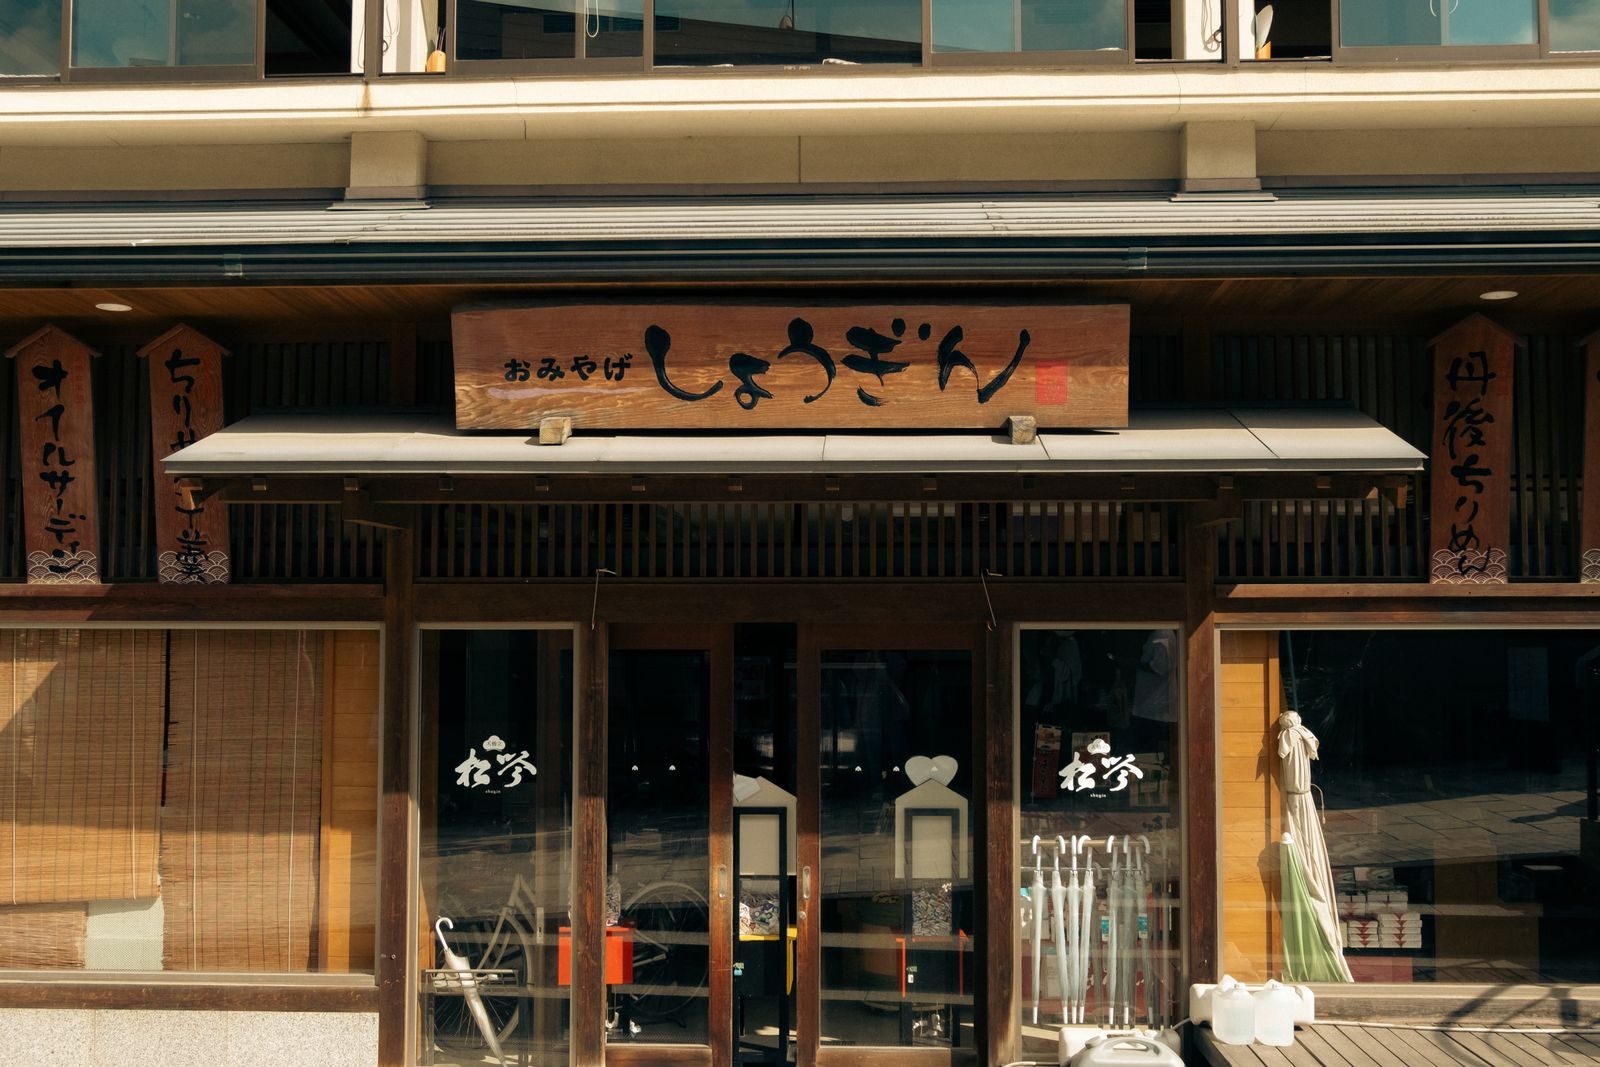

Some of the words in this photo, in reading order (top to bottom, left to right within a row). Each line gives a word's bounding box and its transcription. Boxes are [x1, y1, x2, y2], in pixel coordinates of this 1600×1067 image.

[32, 359, 87, 574] オイルサーディン
[504, 353, 633, 382] おみやげ
[643, 317, 1031, 410] しょうぎん
[1443, 351, 1497, 576] 丹後ちりめん
